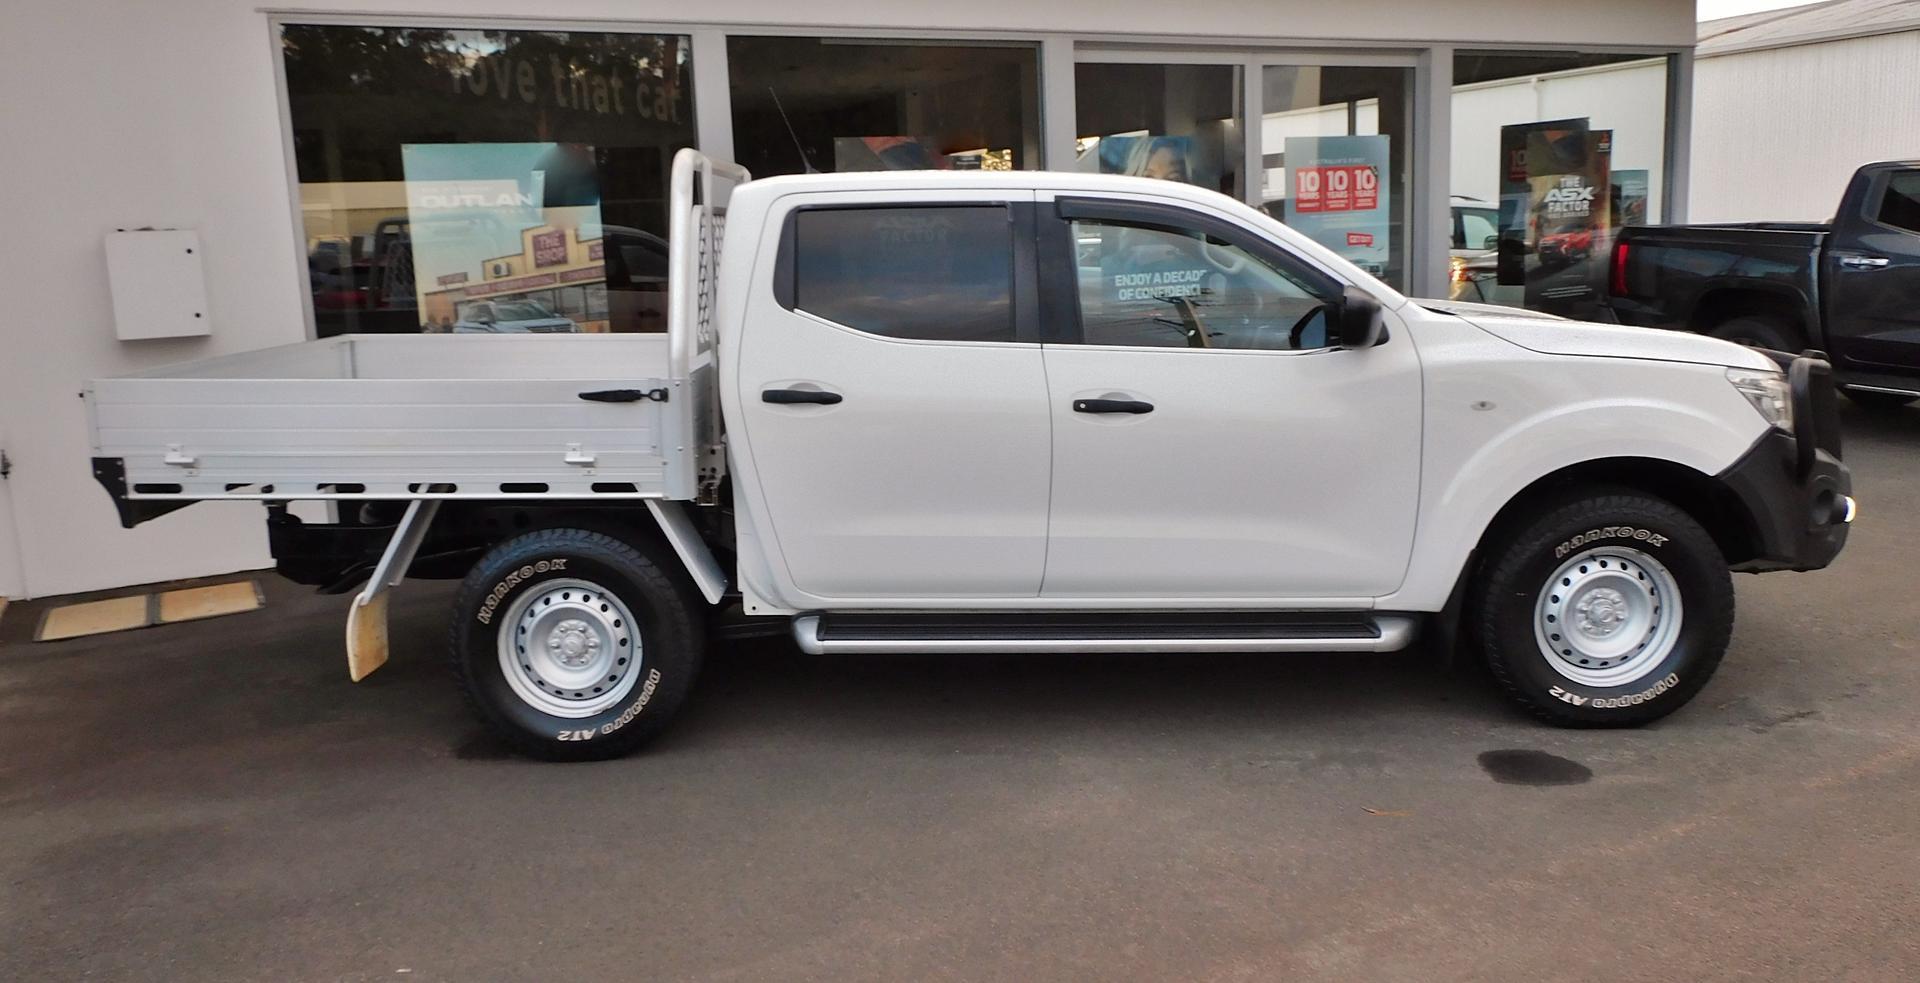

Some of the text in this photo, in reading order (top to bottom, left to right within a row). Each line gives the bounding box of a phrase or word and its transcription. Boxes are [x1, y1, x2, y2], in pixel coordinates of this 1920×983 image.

[550, 54, 626, 115] that
[1298, 169, 1376, 192] 10 10 10
[1560, 177, 1580, 188] THE
[1543, 187, 1595, 203] ASX
[1548, 201, 1590, 213] FACTOR
[538, 232, 561, 249] THE
[1115, 272, 1152, 287] ENJOY
[1153, 272, 1162, 284] A
[1119, 288, 1134, 300] OF
[1548, 672, 1680, 709] Dynapro AT2
[557, 668, 661, 742] Dynapro AT2
